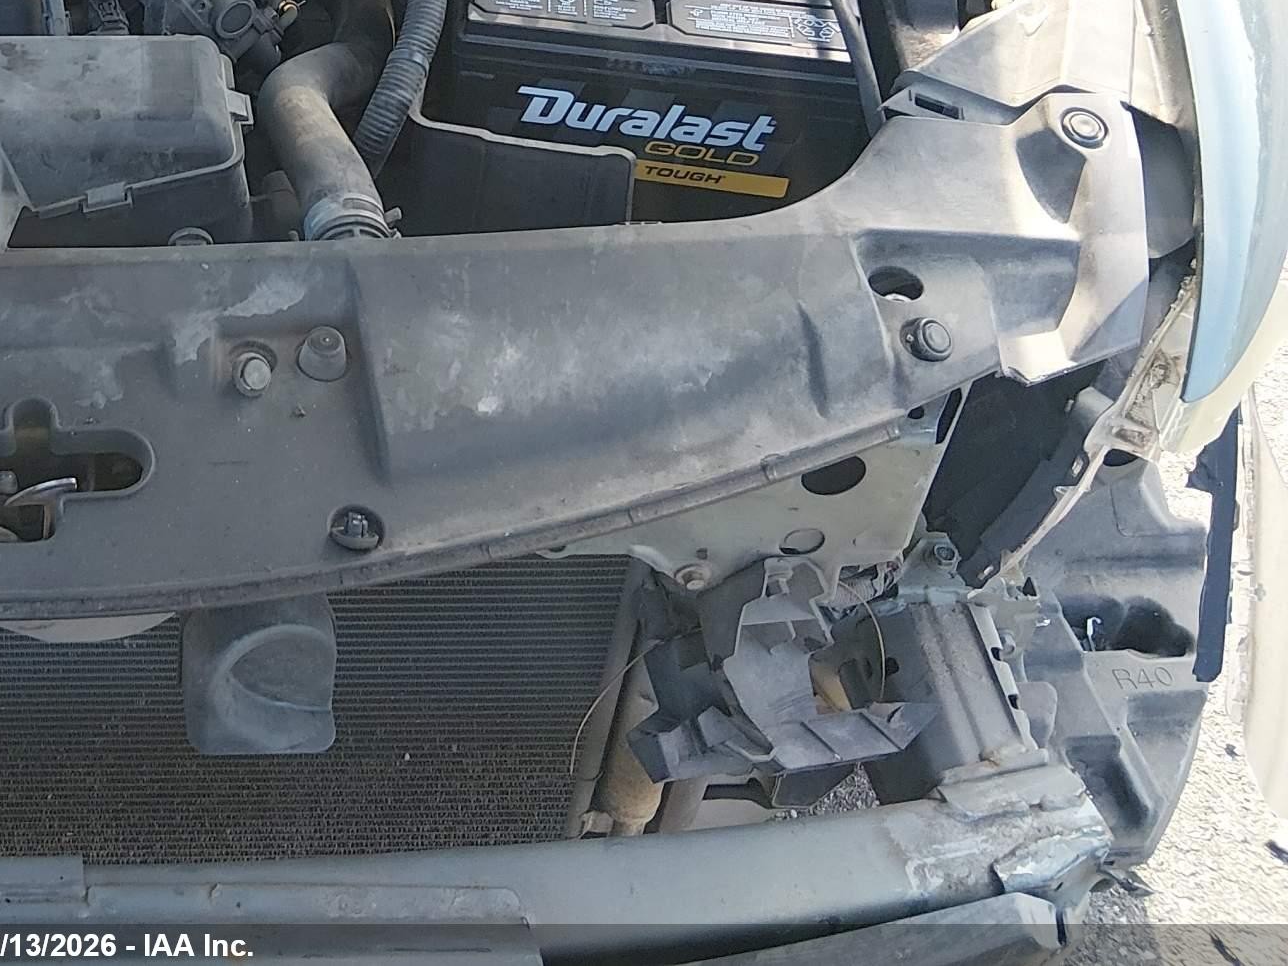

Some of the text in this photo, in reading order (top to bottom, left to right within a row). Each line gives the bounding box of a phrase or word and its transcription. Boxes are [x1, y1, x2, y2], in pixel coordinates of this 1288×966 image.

[517, 85, 777, 152] Duralast
[644, 141, 759, 166] GOLD
[644, 165, 723, 185] TOUGH
[1112, 666, 1174, 690] R40
